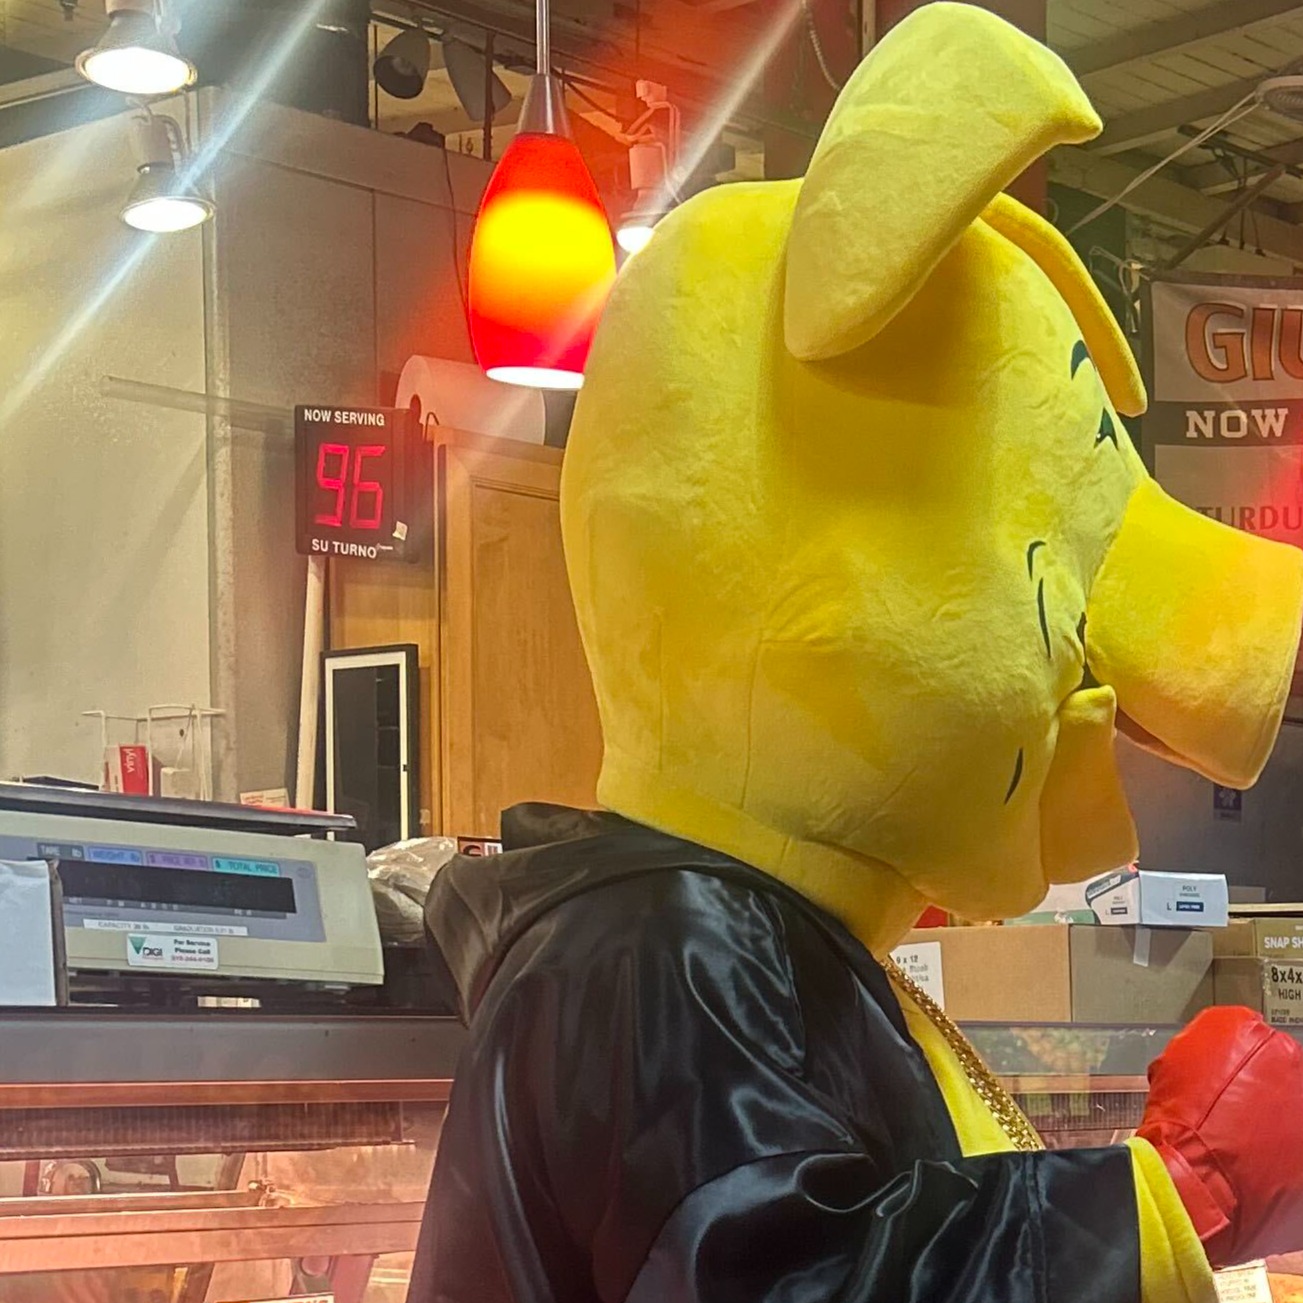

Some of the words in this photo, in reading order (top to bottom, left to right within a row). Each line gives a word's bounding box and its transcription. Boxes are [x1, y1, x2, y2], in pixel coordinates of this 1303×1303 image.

[304, 408, 332, 423] NOW
[334, 411, 385, 426] SERVING
[1186, 408, 1288, 438] NOW
[315, 442, 386, 529] 96
[312, 538, 329, 552] SU
[332, 541, 377, 559] TURNO
[1264, 936, 1290, 949] SNAP
[1278, 988, 1300, 1000] HIGH
